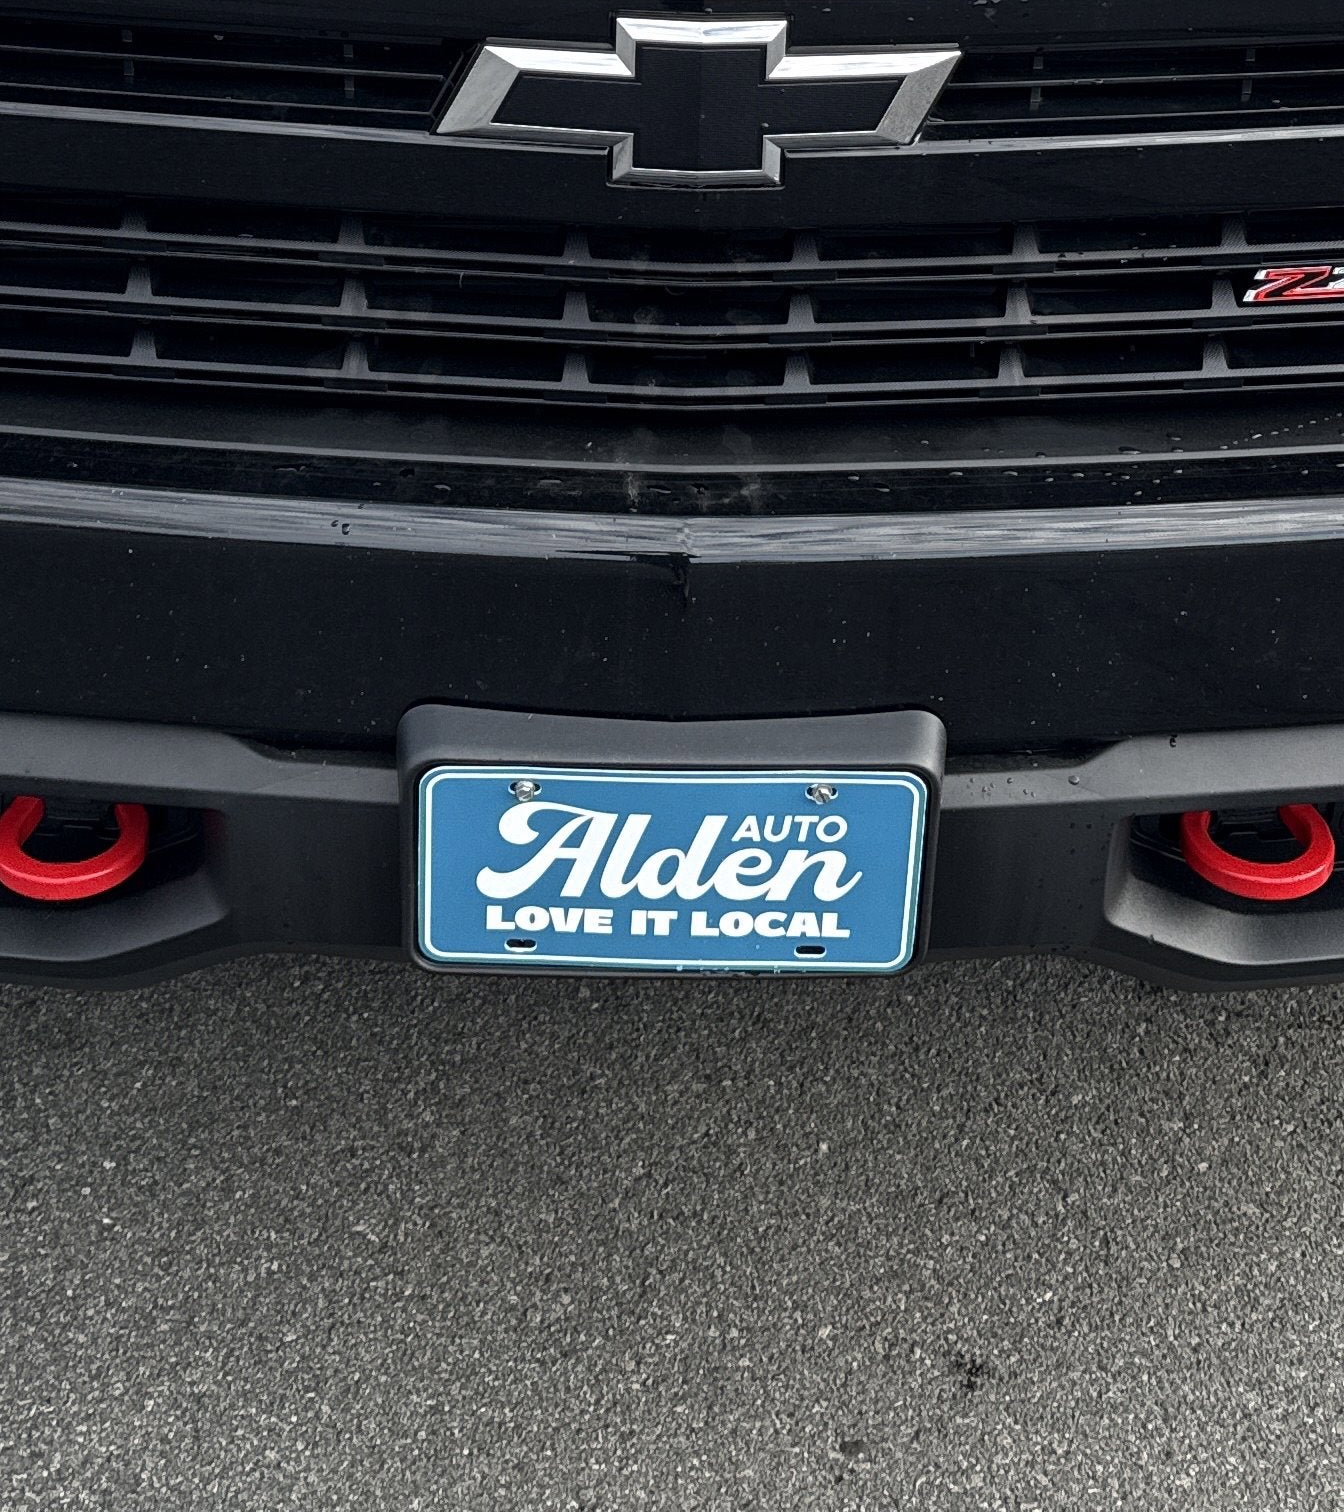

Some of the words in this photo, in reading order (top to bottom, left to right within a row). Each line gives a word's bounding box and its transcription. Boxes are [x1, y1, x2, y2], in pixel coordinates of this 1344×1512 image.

[731, 814, 849, 844] AUTO
[475, 800, 864, 902] Alden
[485, 904, 615, 935] LOVE
[629, 909, 679, 937] IT
[690, 910, 852, 939] LOCAL
